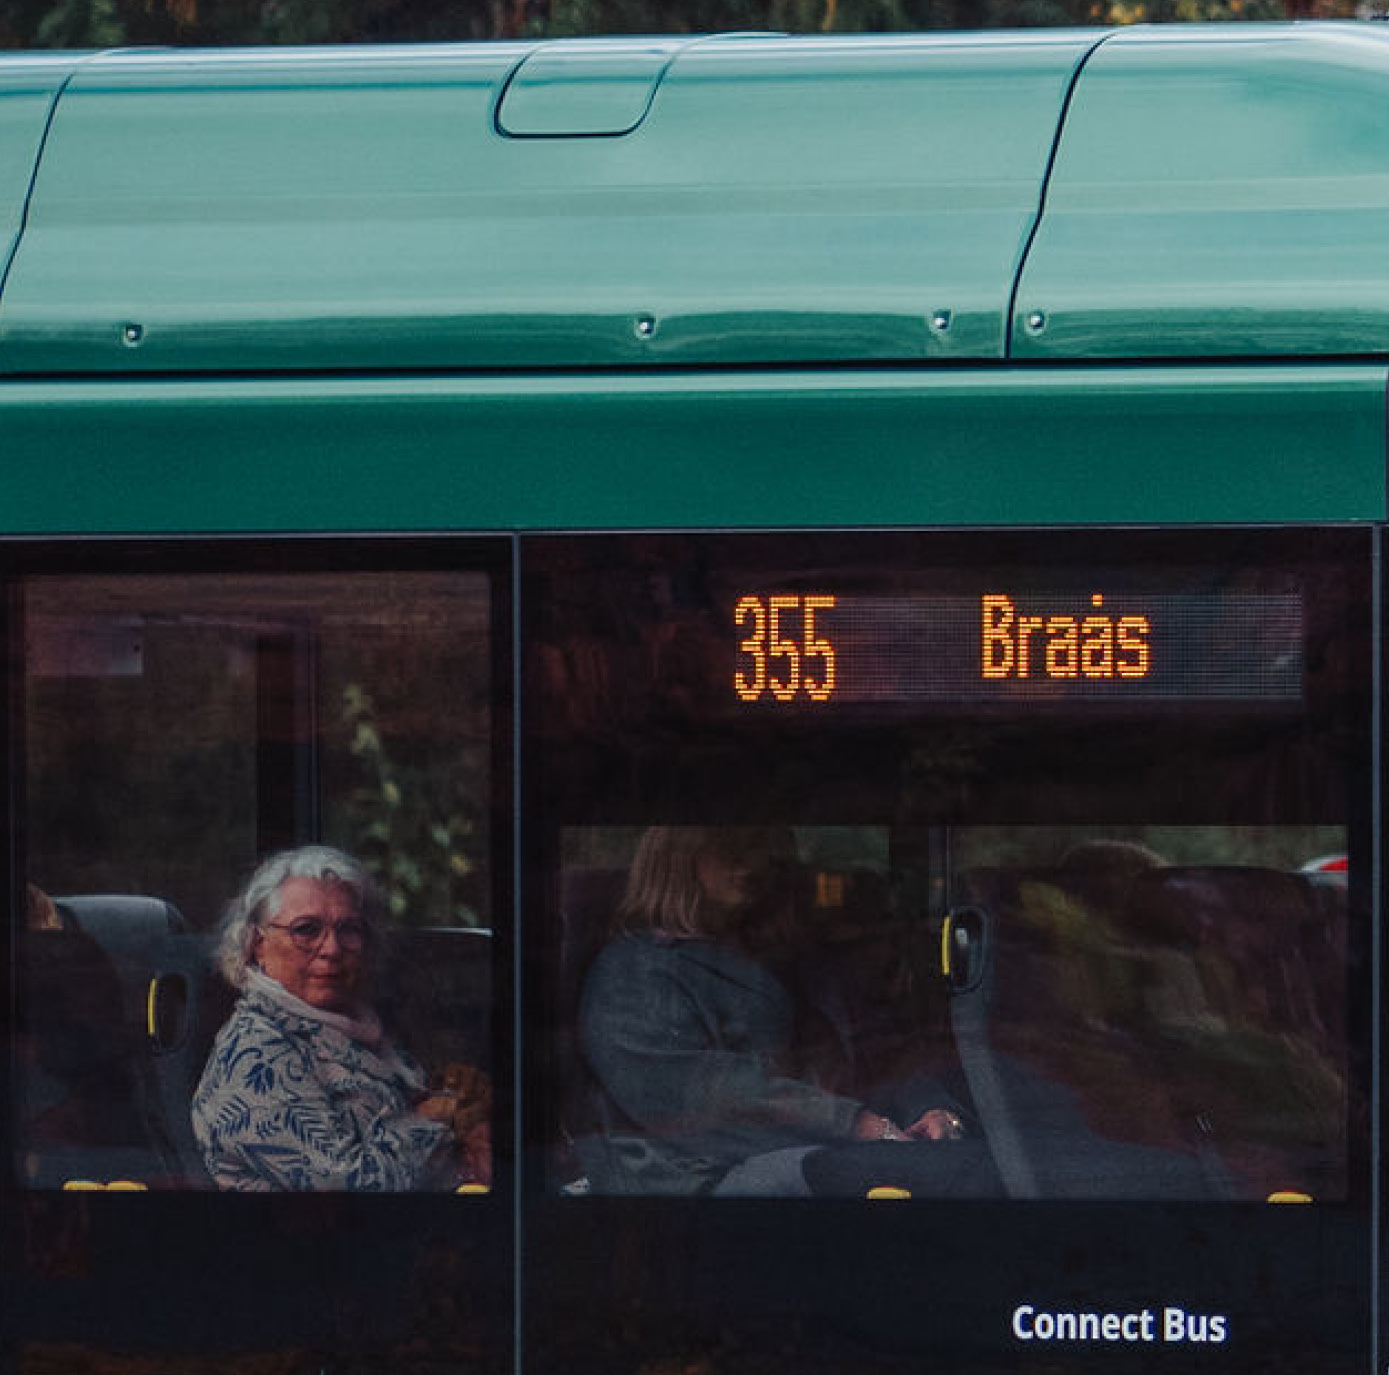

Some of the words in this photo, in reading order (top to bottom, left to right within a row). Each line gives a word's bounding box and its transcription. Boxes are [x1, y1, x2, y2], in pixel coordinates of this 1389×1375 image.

[734, 595, 836, 701] 355
[1011, 1305, 1154, 1343] Connect
[1163, 1306, 1227, 1344] Bus
